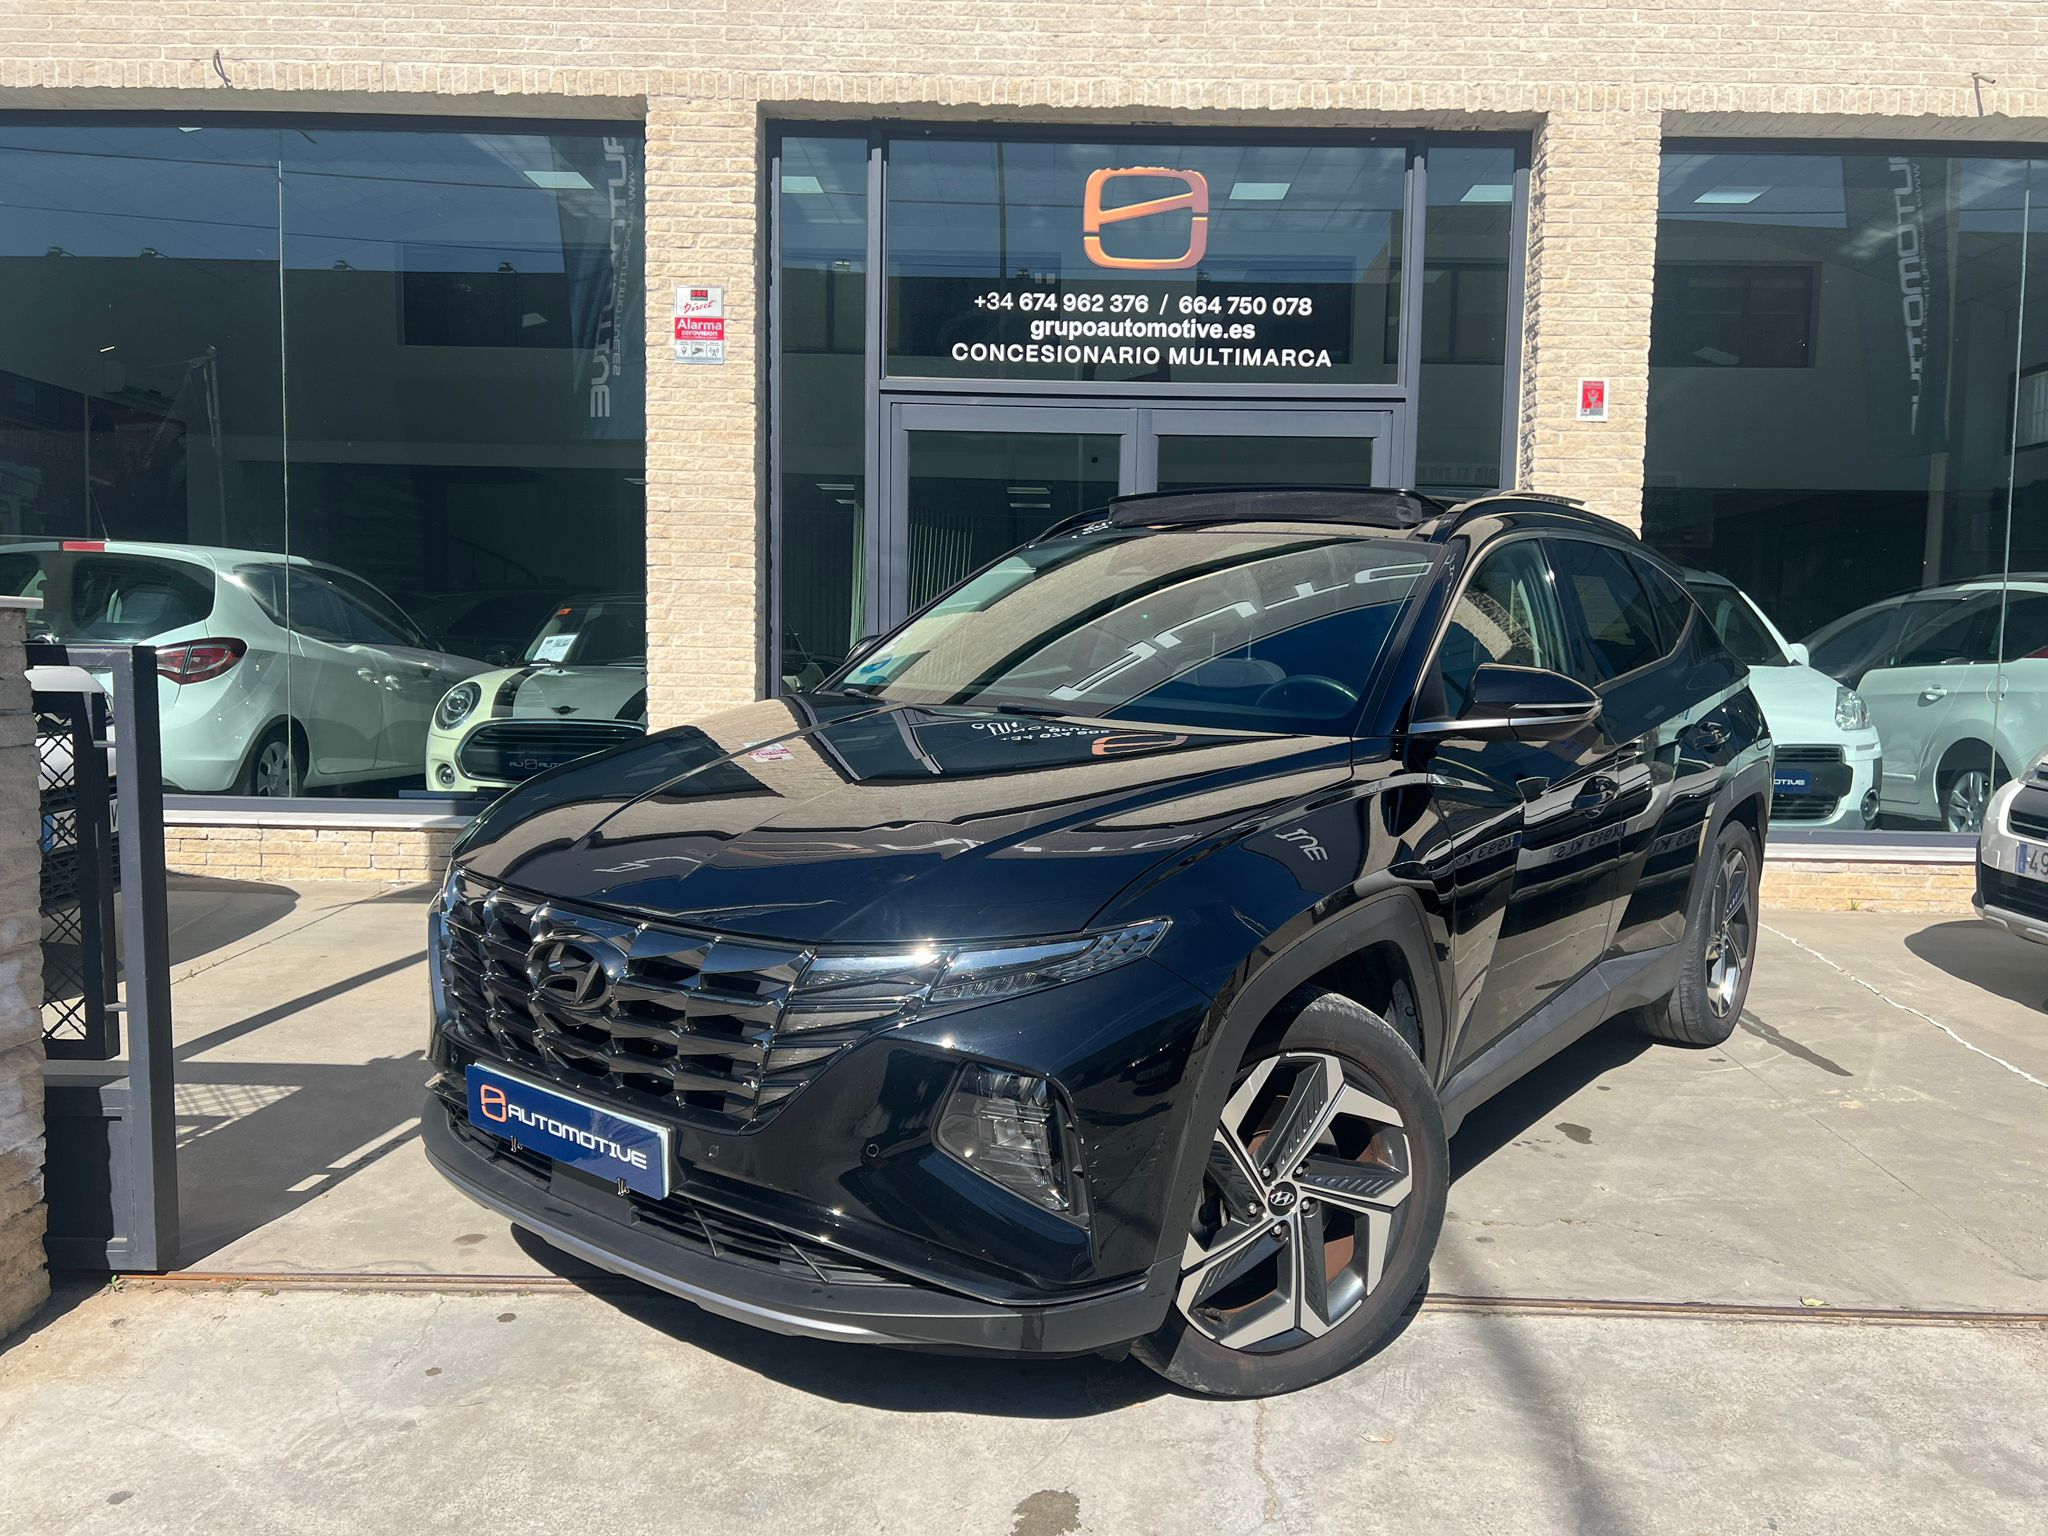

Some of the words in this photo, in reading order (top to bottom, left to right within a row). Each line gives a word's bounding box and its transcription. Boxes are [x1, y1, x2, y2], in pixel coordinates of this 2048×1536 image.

[974, 291, 1014, 311] +34
[1018, 292, 1058, 312] 674
[1062, 293, 1105, 313] 962
[1109, 293, 1149, 314] 376
[1158, 293, 1169, 316] /
[1178, 295, 1222, 315] 664
[1226, 296, 1267, 316] 750
[1272, 296, 1313, 316] 078
[677, 318, 722, 330] Alarma
[1030, 317, 1256, 341] grupoautomotive.es
[951, 342, 1161, 365] CONCESIONARIO
[1168, 346, 1332, 368] MULTIMARCA
[508, 1103, 648, 1170] AUTOMOTIVE
